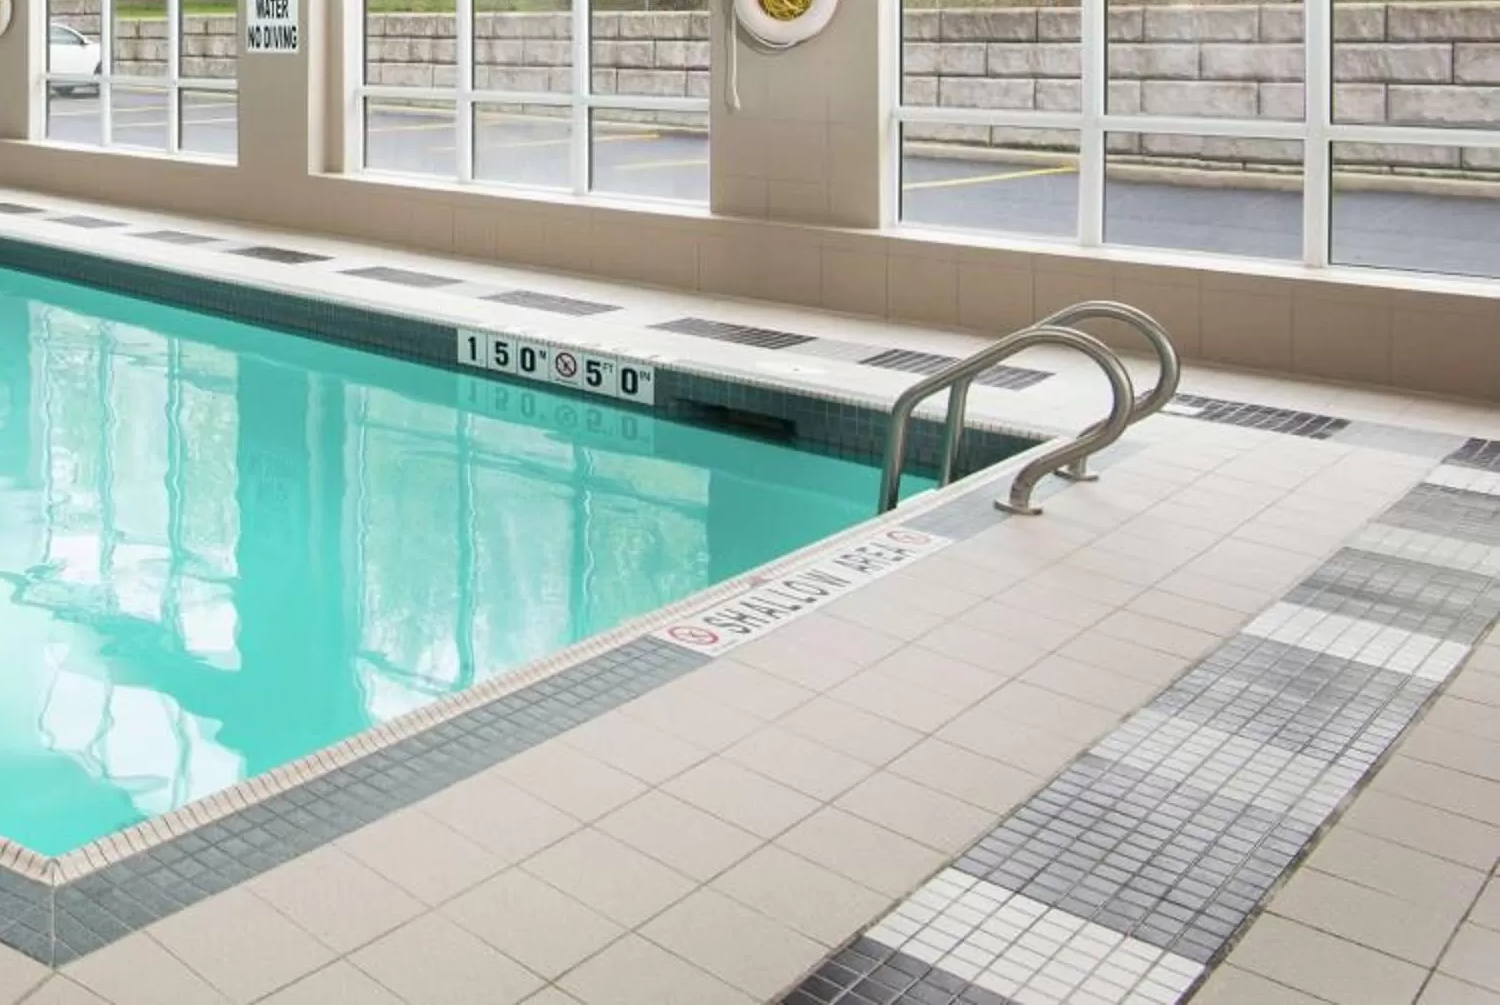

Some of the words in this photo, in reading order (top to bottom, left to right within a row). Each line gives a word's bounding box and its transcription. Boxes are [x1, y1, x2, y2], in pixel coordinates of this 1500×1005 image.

[247, 25, 261, 49] NO
[263, 25, 297, 49] DIVING
[703, 568, 853, 635] SHALLOW
[833, 542, 917, 575] AREA
